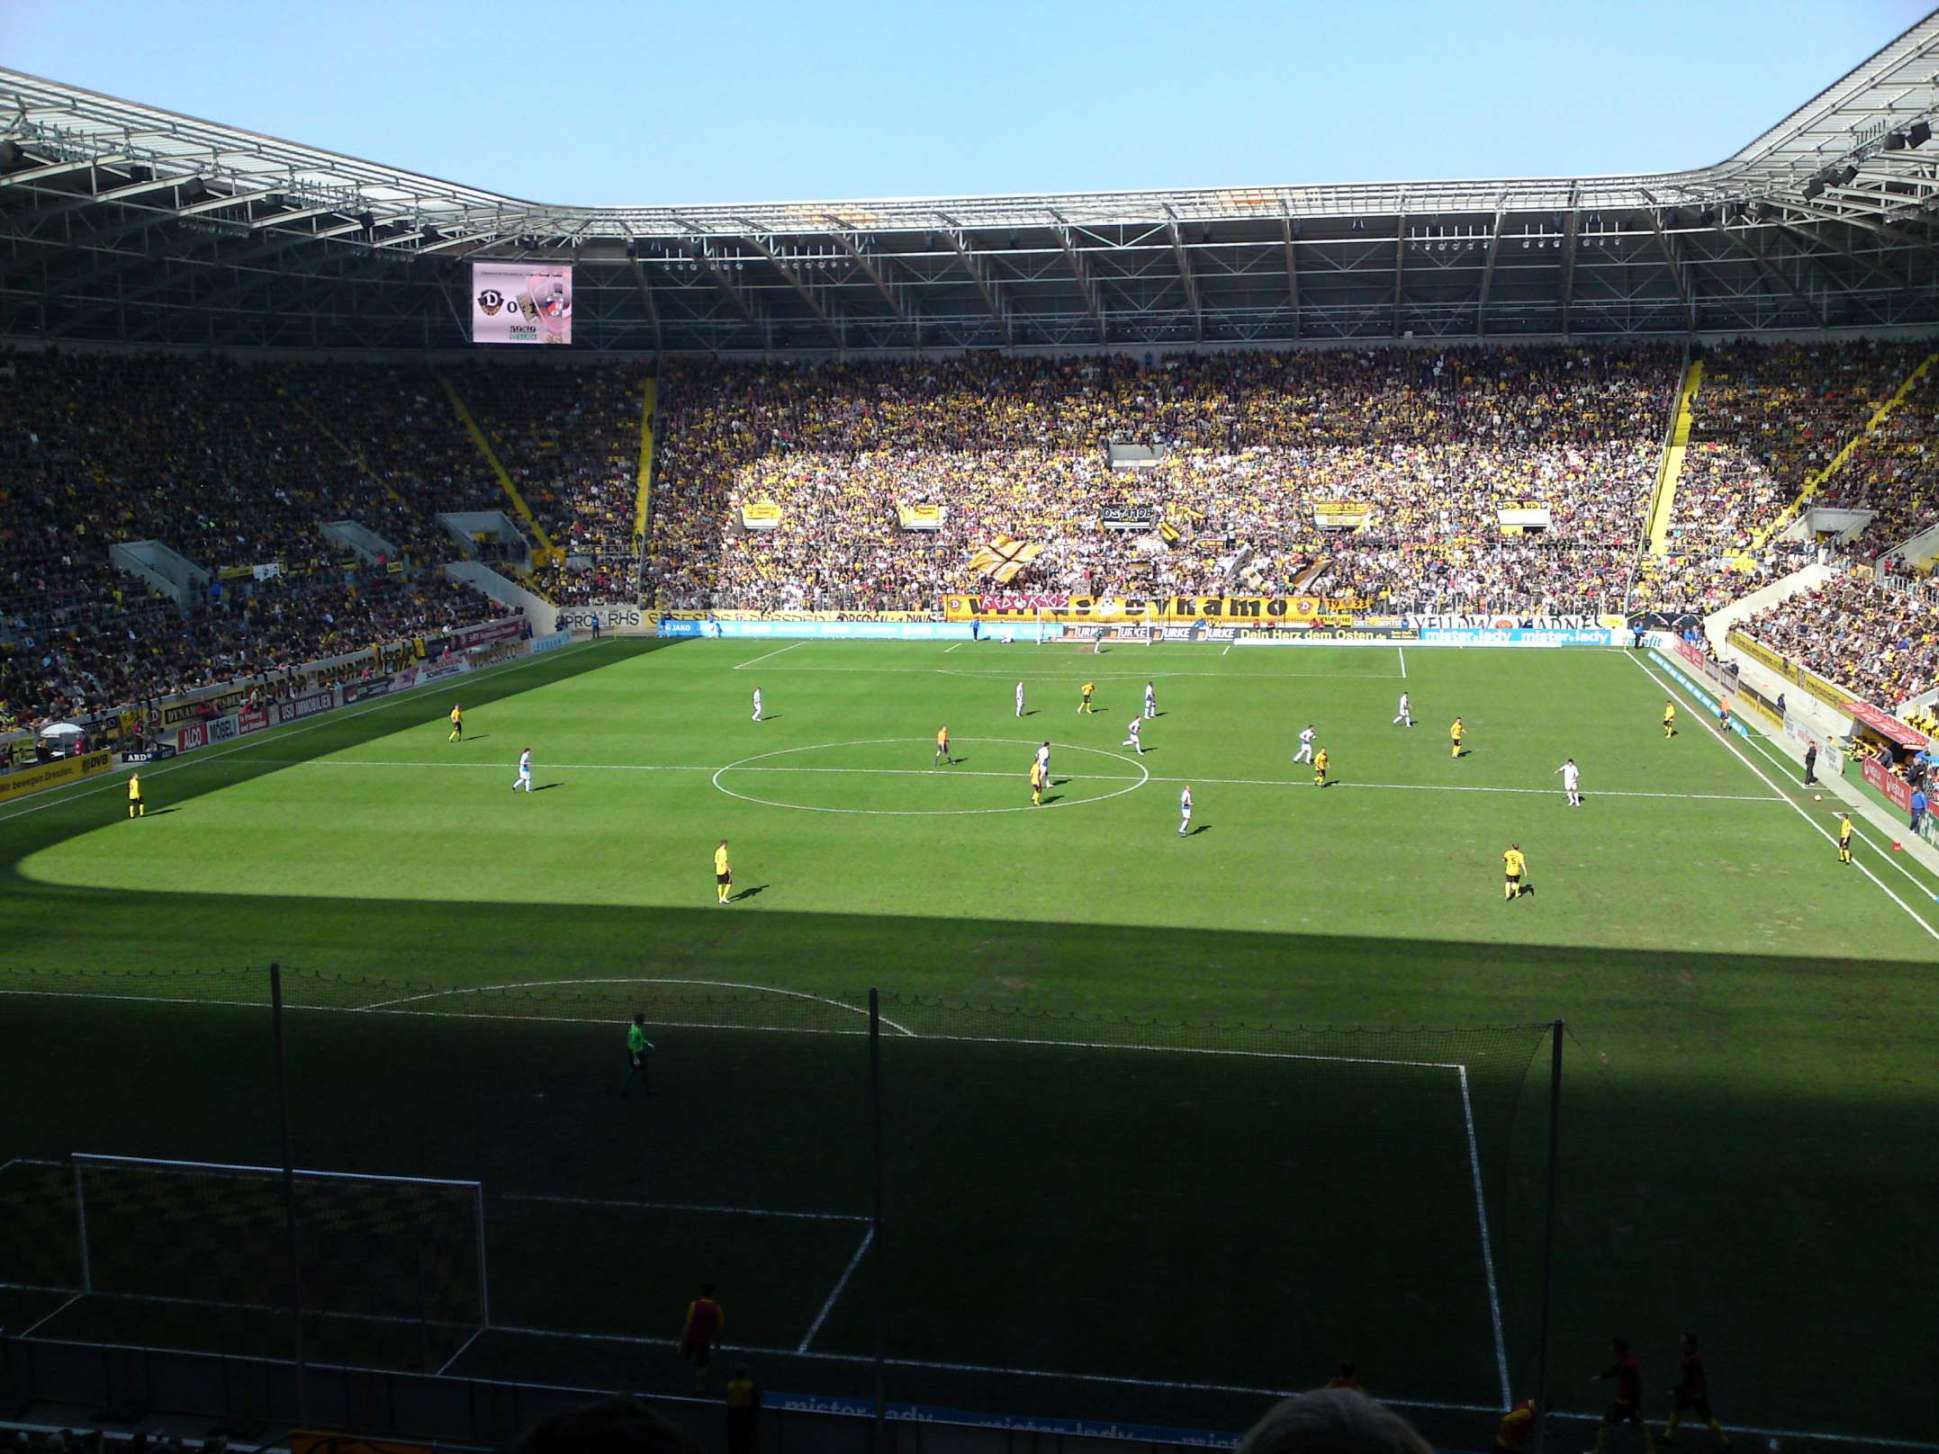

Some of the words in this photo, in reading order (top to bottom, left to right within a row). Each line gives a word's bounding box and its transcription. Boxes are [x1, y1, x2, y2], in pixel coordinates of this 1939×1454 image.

[608, 611, 640, 626] RHS
[1240, 629, 1269, 640] Dein
[1273, 629, 1300, 641] Herz
[1306, 629, 1332, 640] dem
